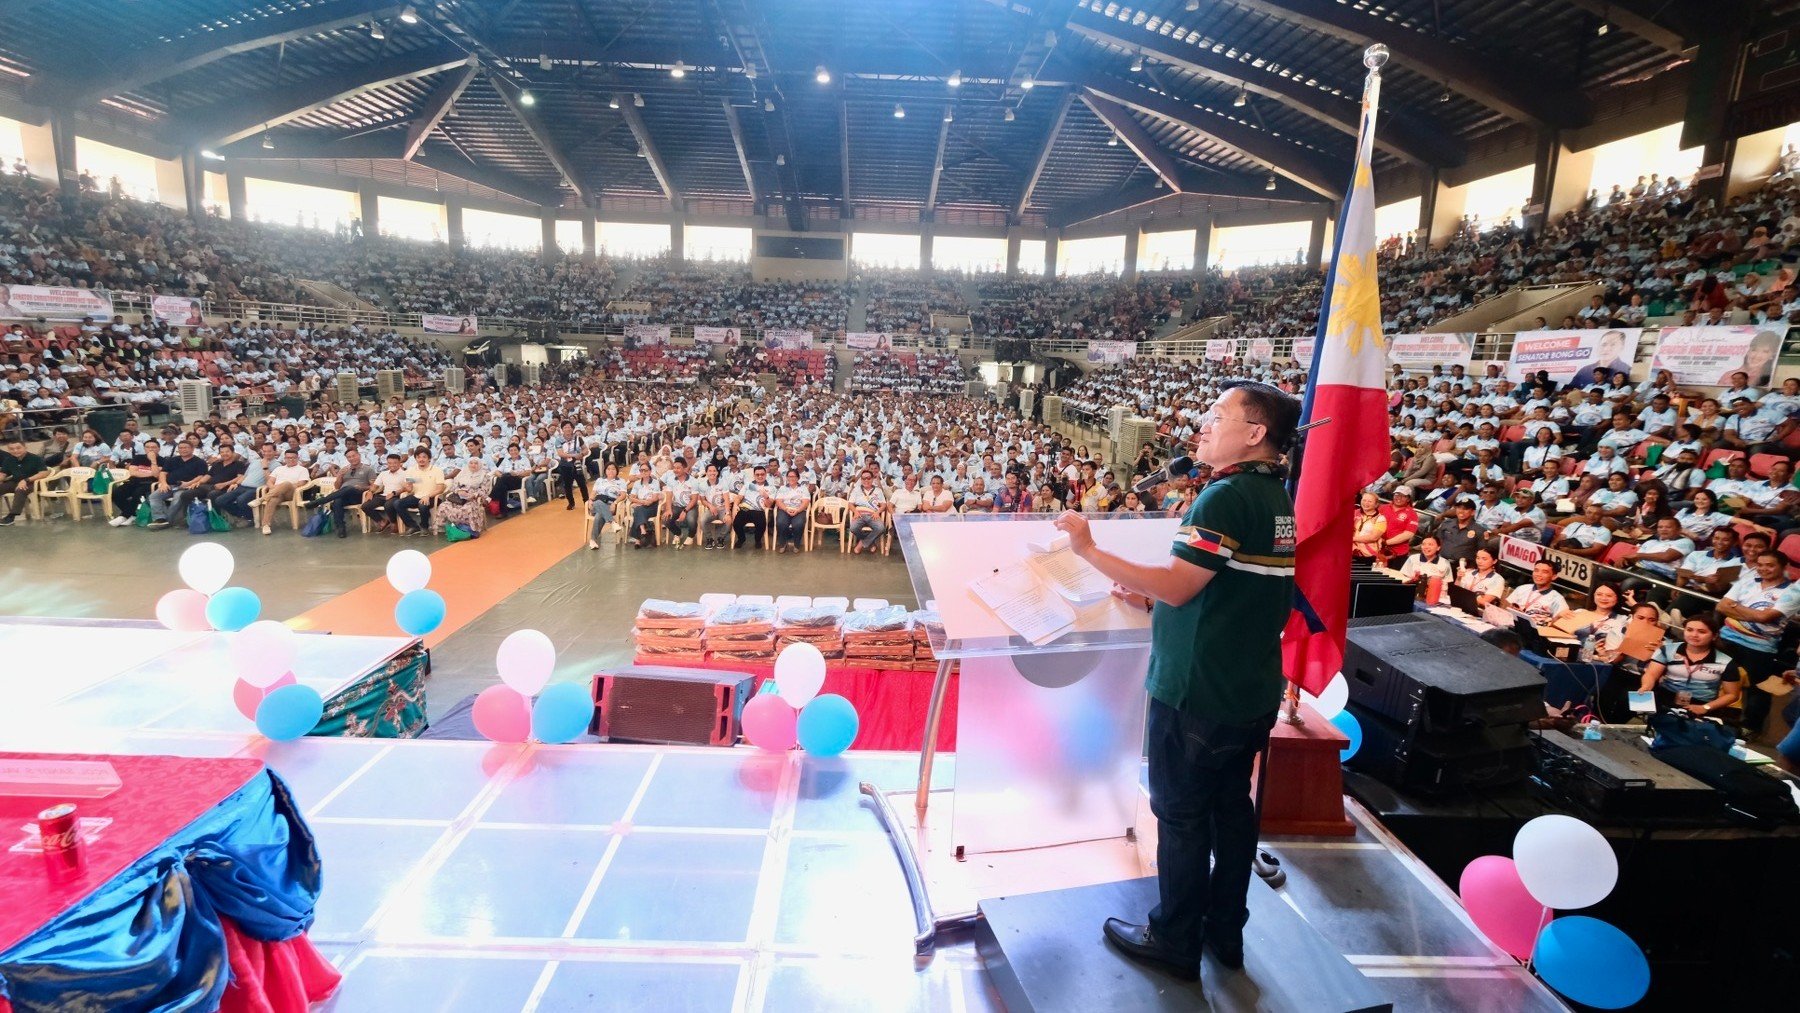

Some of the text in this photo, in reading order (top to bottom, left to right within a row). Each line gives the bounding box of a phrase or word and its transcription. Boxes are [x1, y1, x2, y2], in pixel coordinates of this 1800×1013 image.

[1524, 340, 1570, 351] WELCOME
[1518, 348, 1591, 361] SENATOR BONG GO
[1506, 544, 1537, 563] MAIGO
